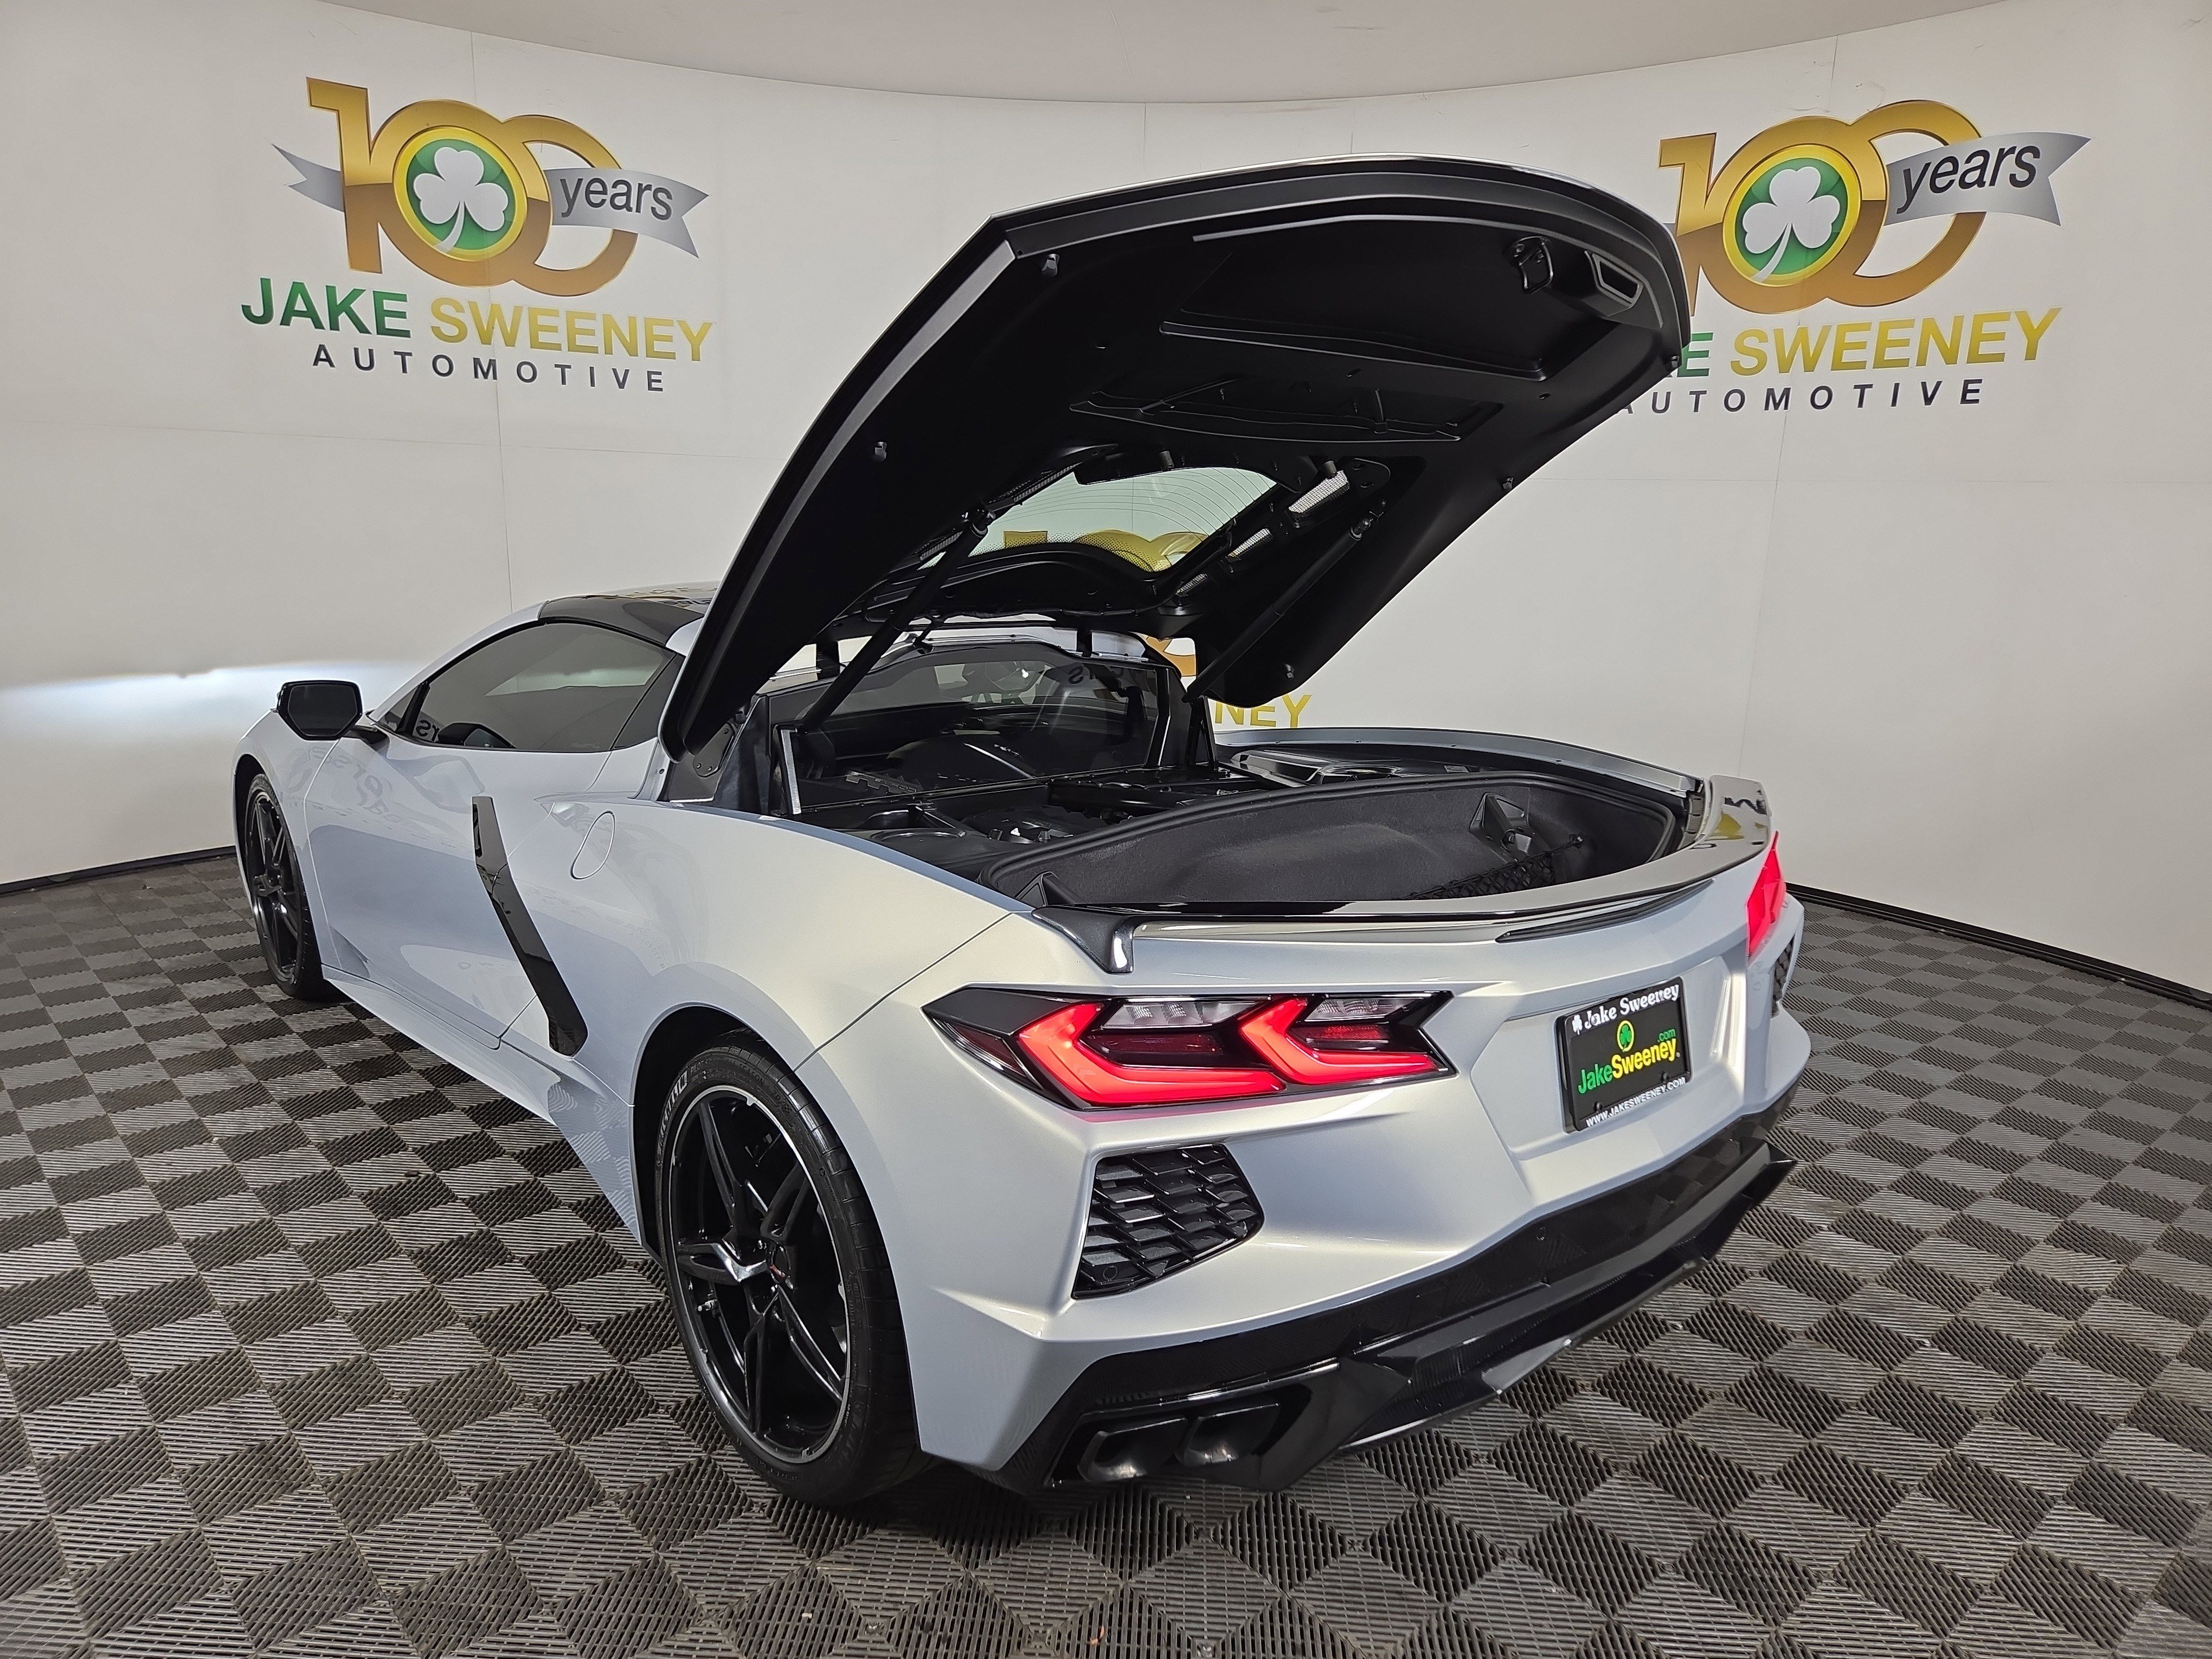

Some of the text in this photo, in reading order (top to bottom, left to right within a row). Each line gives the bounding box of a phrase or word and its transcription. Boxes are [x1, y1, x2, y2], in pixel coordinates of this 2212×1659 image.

[306, 76, 639, 297] 100
[560, 178, 674, 221] years
[1896, 144, 2040, 215] years
[241, 277, 714, 362] JAKE SWEENEY
[1731, 307, 2063, 377] SWEENEY
[313, 344, 664, 392] AUTOMOTIVE
[1584, 984, 1680, 1029] Jake Sweeney
[1657, 1028, 1676, 1042] .com
[1586, 1077, 1686, 1128] WWW.JAKESWEENEY.COM
